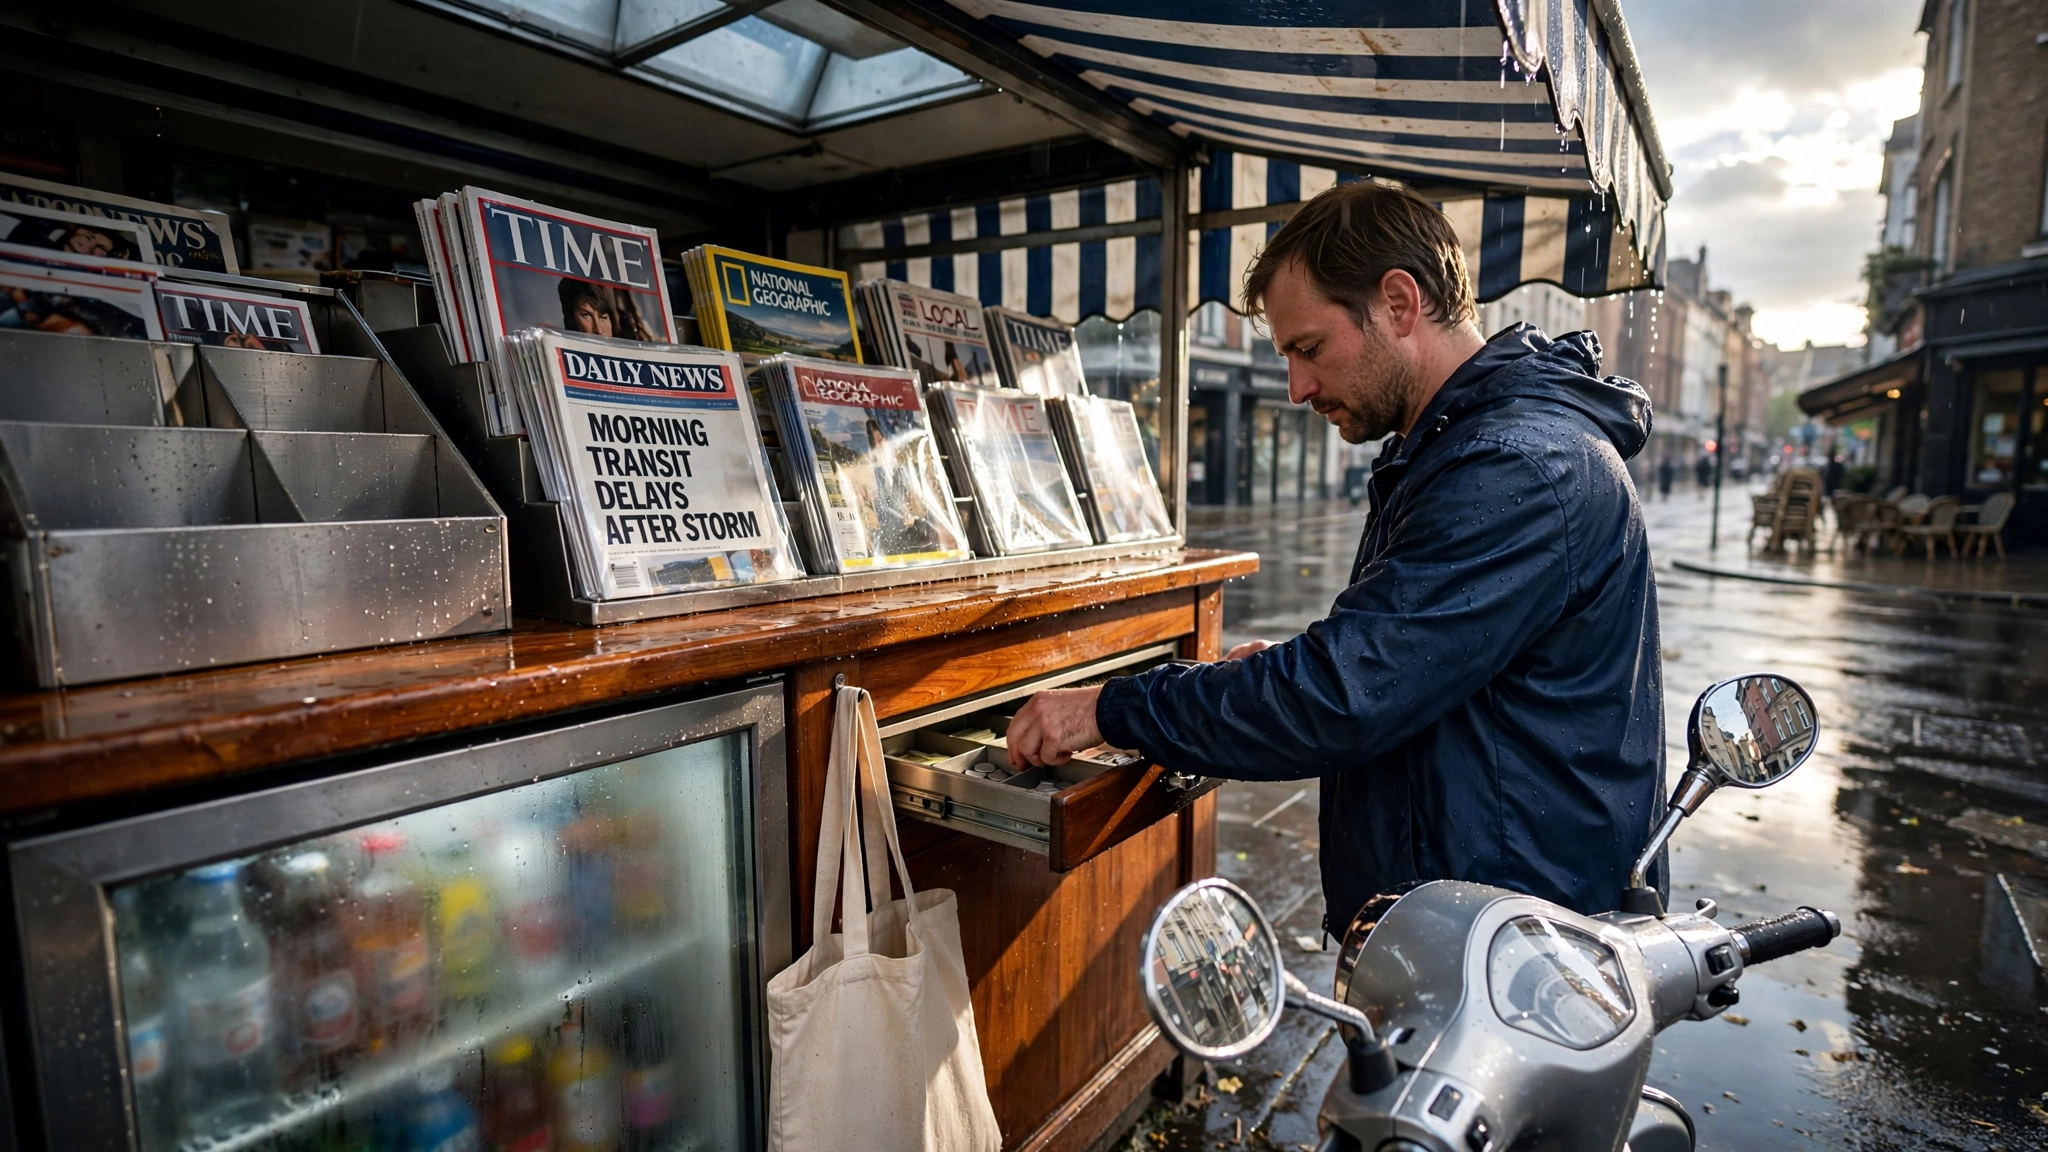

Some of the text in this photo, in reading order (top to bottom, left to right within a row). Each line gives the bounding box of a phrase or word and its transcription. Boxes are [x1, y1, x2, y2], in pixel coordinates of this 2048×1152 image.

[490, 207, 650, 289] TIME
[750, 270, 813, 298] NATIONAL
[161, 293, 299, 341] TIME
[753, 288, 832, 316] GEOGRAPHIC
[919, 300, 979, 330] LOCAL
[563, 351, 724, 391] DAILY NEWS
[587, 412, 709, 446] MORNING
[586, 446, 692, 477] TRANSIT
[594, 480, 689, 509] DELAYS
[607, 511, 761, 545] AFTER STORM
